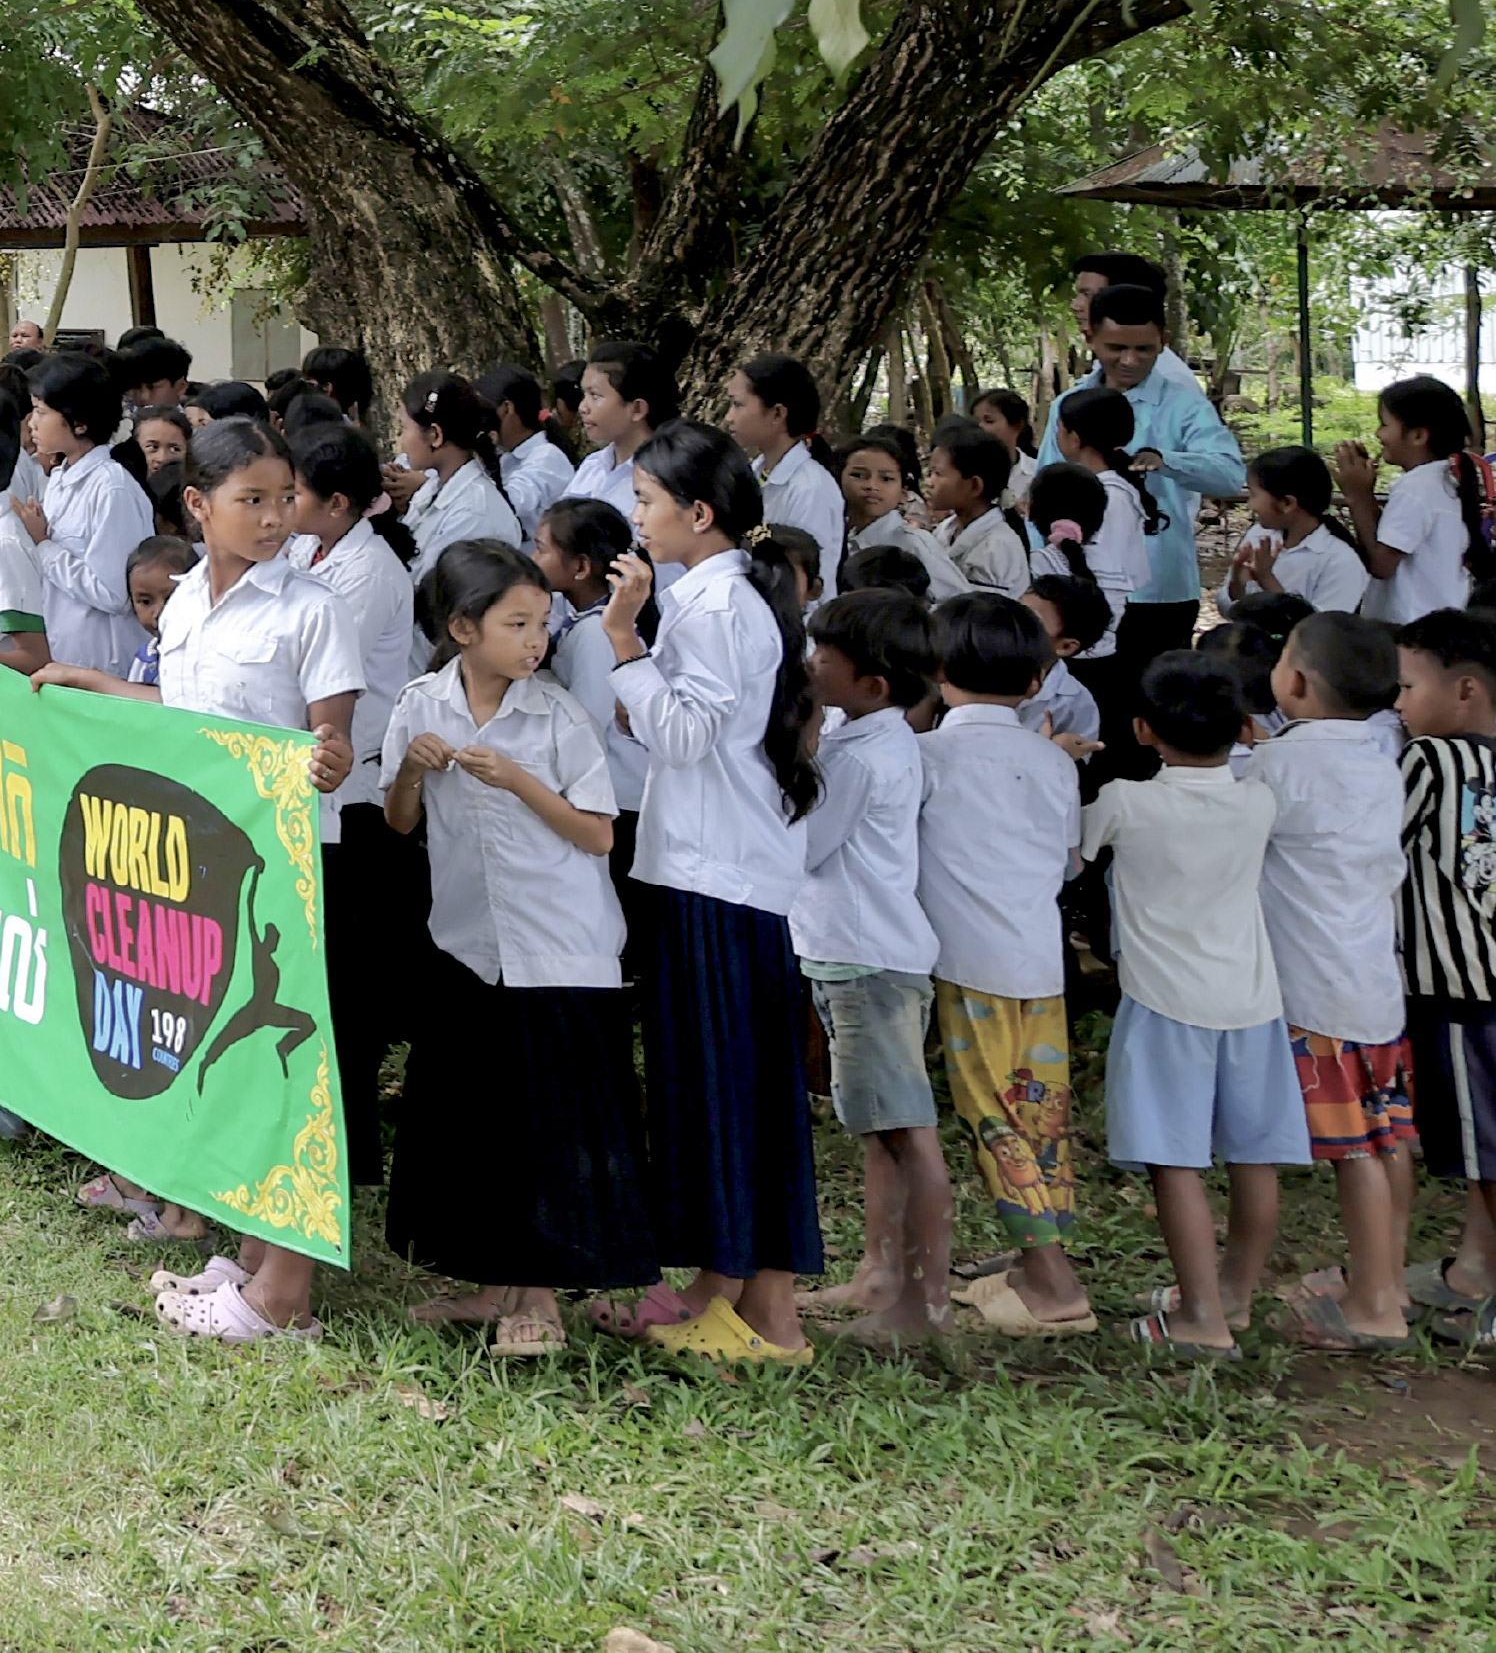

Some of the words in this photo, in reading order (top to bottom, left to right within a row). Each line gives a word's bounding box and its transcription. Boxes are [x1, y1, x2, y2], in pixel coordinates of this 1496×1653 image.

[79, 793, 190, 903] WORLD
[84, 882, 224, 1007] CLEANUP
[93, 968, 144, 1070] DAY
[150, 1008, 187, 1054] 198
